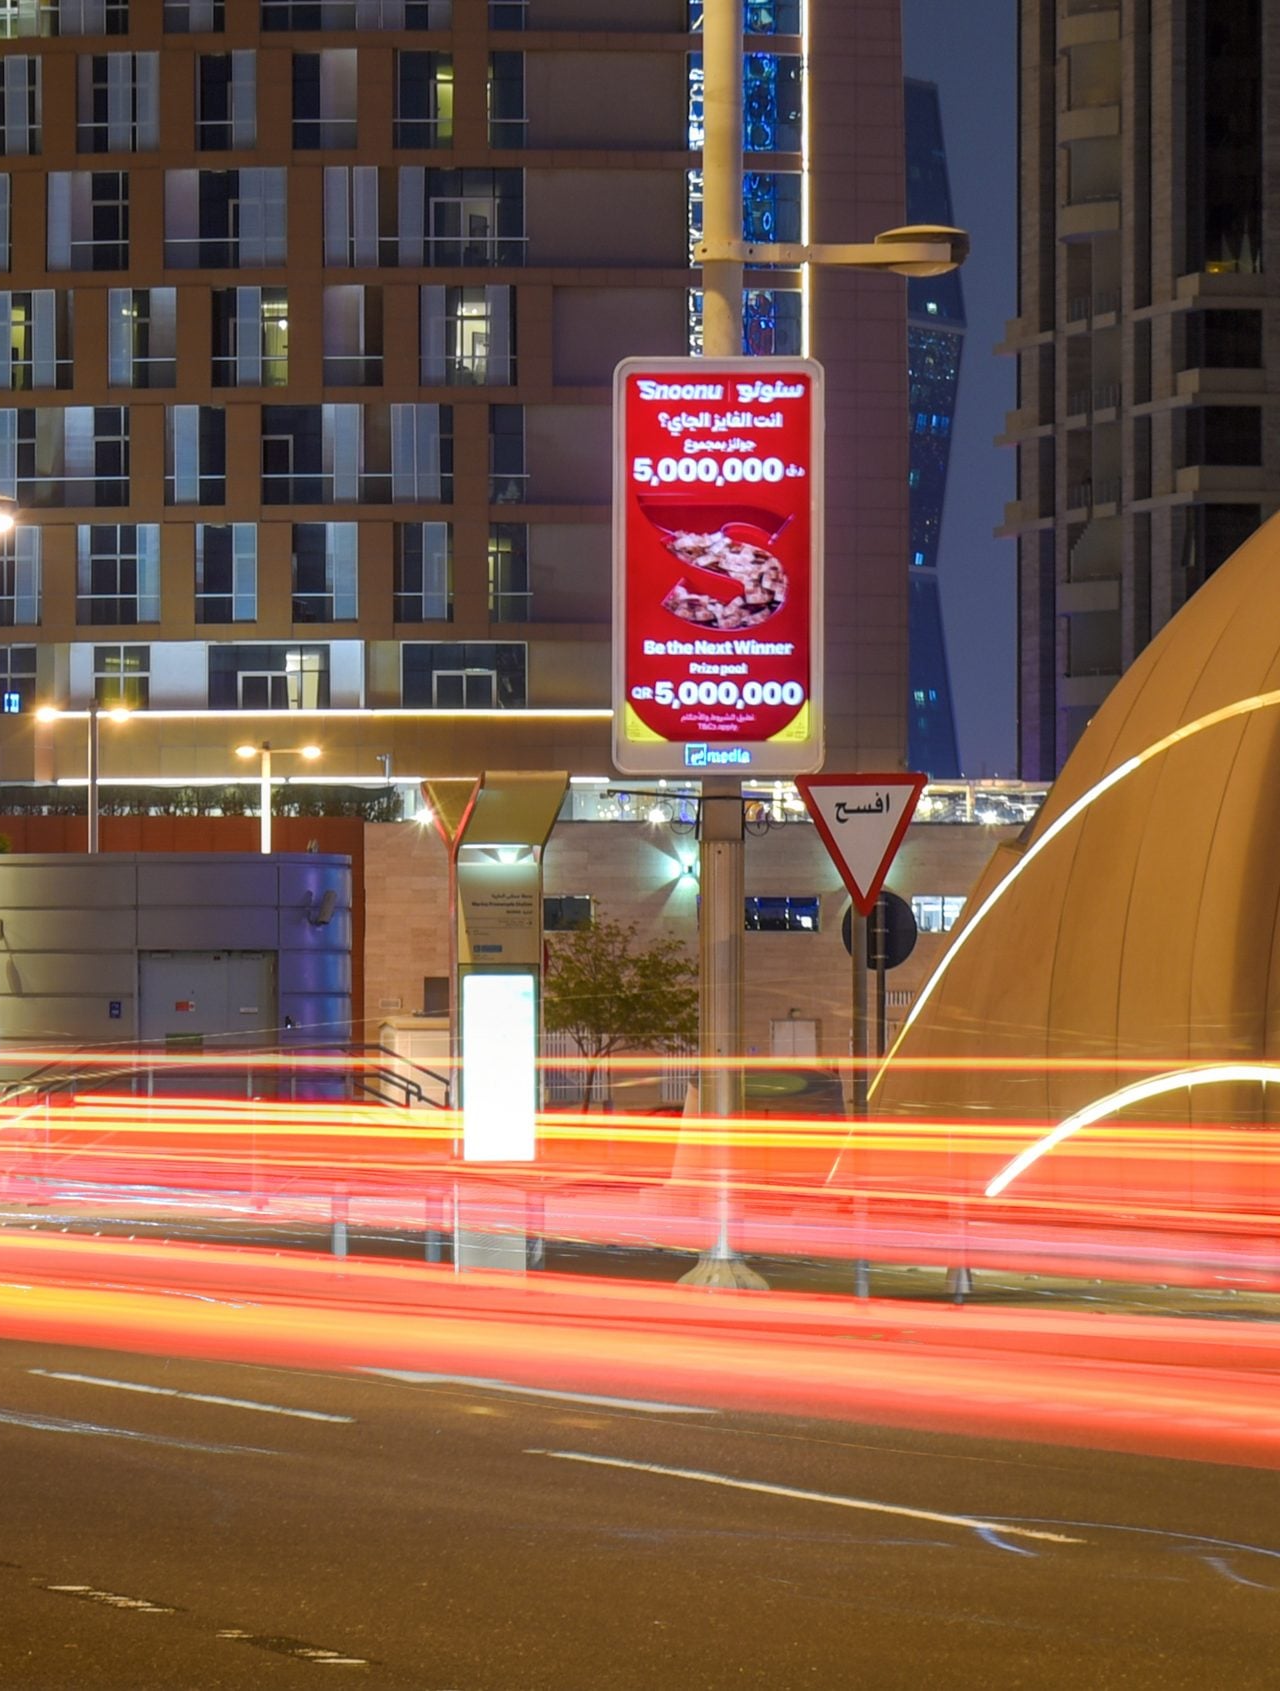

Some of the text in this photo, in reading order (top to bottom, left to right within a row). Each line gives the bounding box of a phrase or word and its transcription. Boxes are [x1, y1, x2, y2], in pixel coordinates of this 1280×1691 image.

[637, 380, 724, 400] Snoonu
[736, 381, 805, 403] سنونو
[633, 457, 784, 487] 5,000,000
[643, 639, 795, 655] Be the Next Winner
[689, 662, 720, 675] Prize
[631, 680, 804, 709] QR 5,000,000
[707, 748, 751, 764] media
[835, 792, 890, 823] افسح
